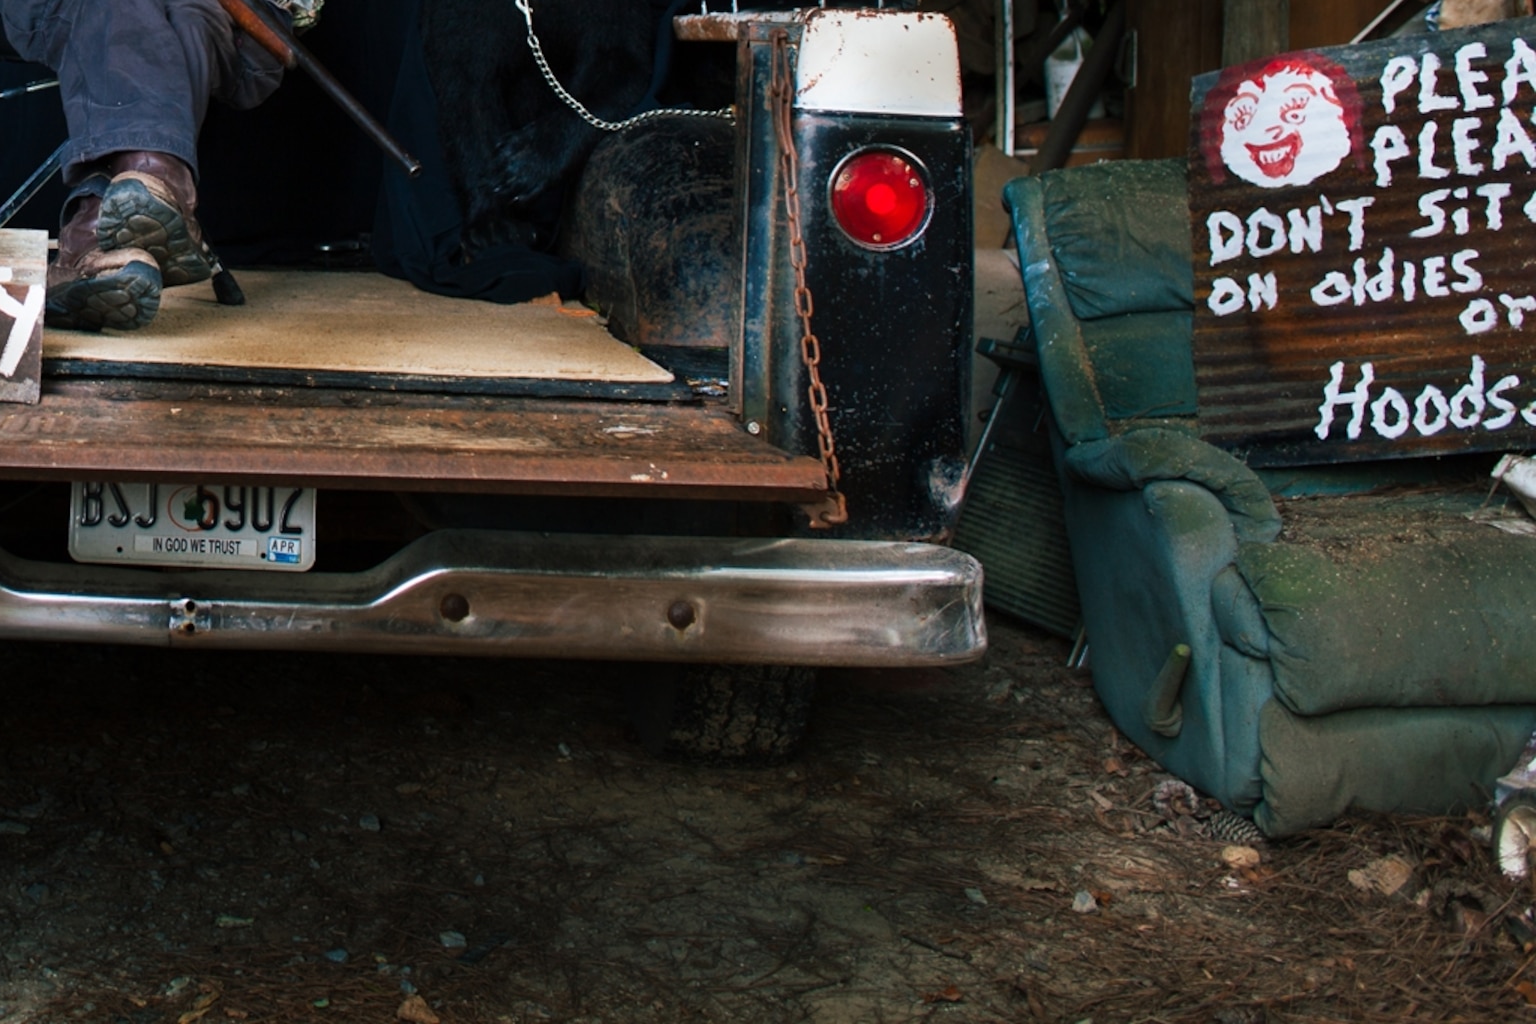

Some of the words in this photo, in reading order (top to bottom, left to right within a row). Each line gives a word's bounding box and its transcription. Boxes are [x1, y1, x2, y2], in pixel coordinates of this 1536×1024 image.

[1380, 37, 1536, 114] PLEA
[1369, 107, 1536, 188] PLEA
[1205, 195, 1375, 266] DON'T
[153, 537, 162, 551] IN
[165, 538, 188, 552] GOD
[190, 539, 206, 553] WE
[209, 540, 241, 555] TRUST
[271, 540, 295, 553] APR
